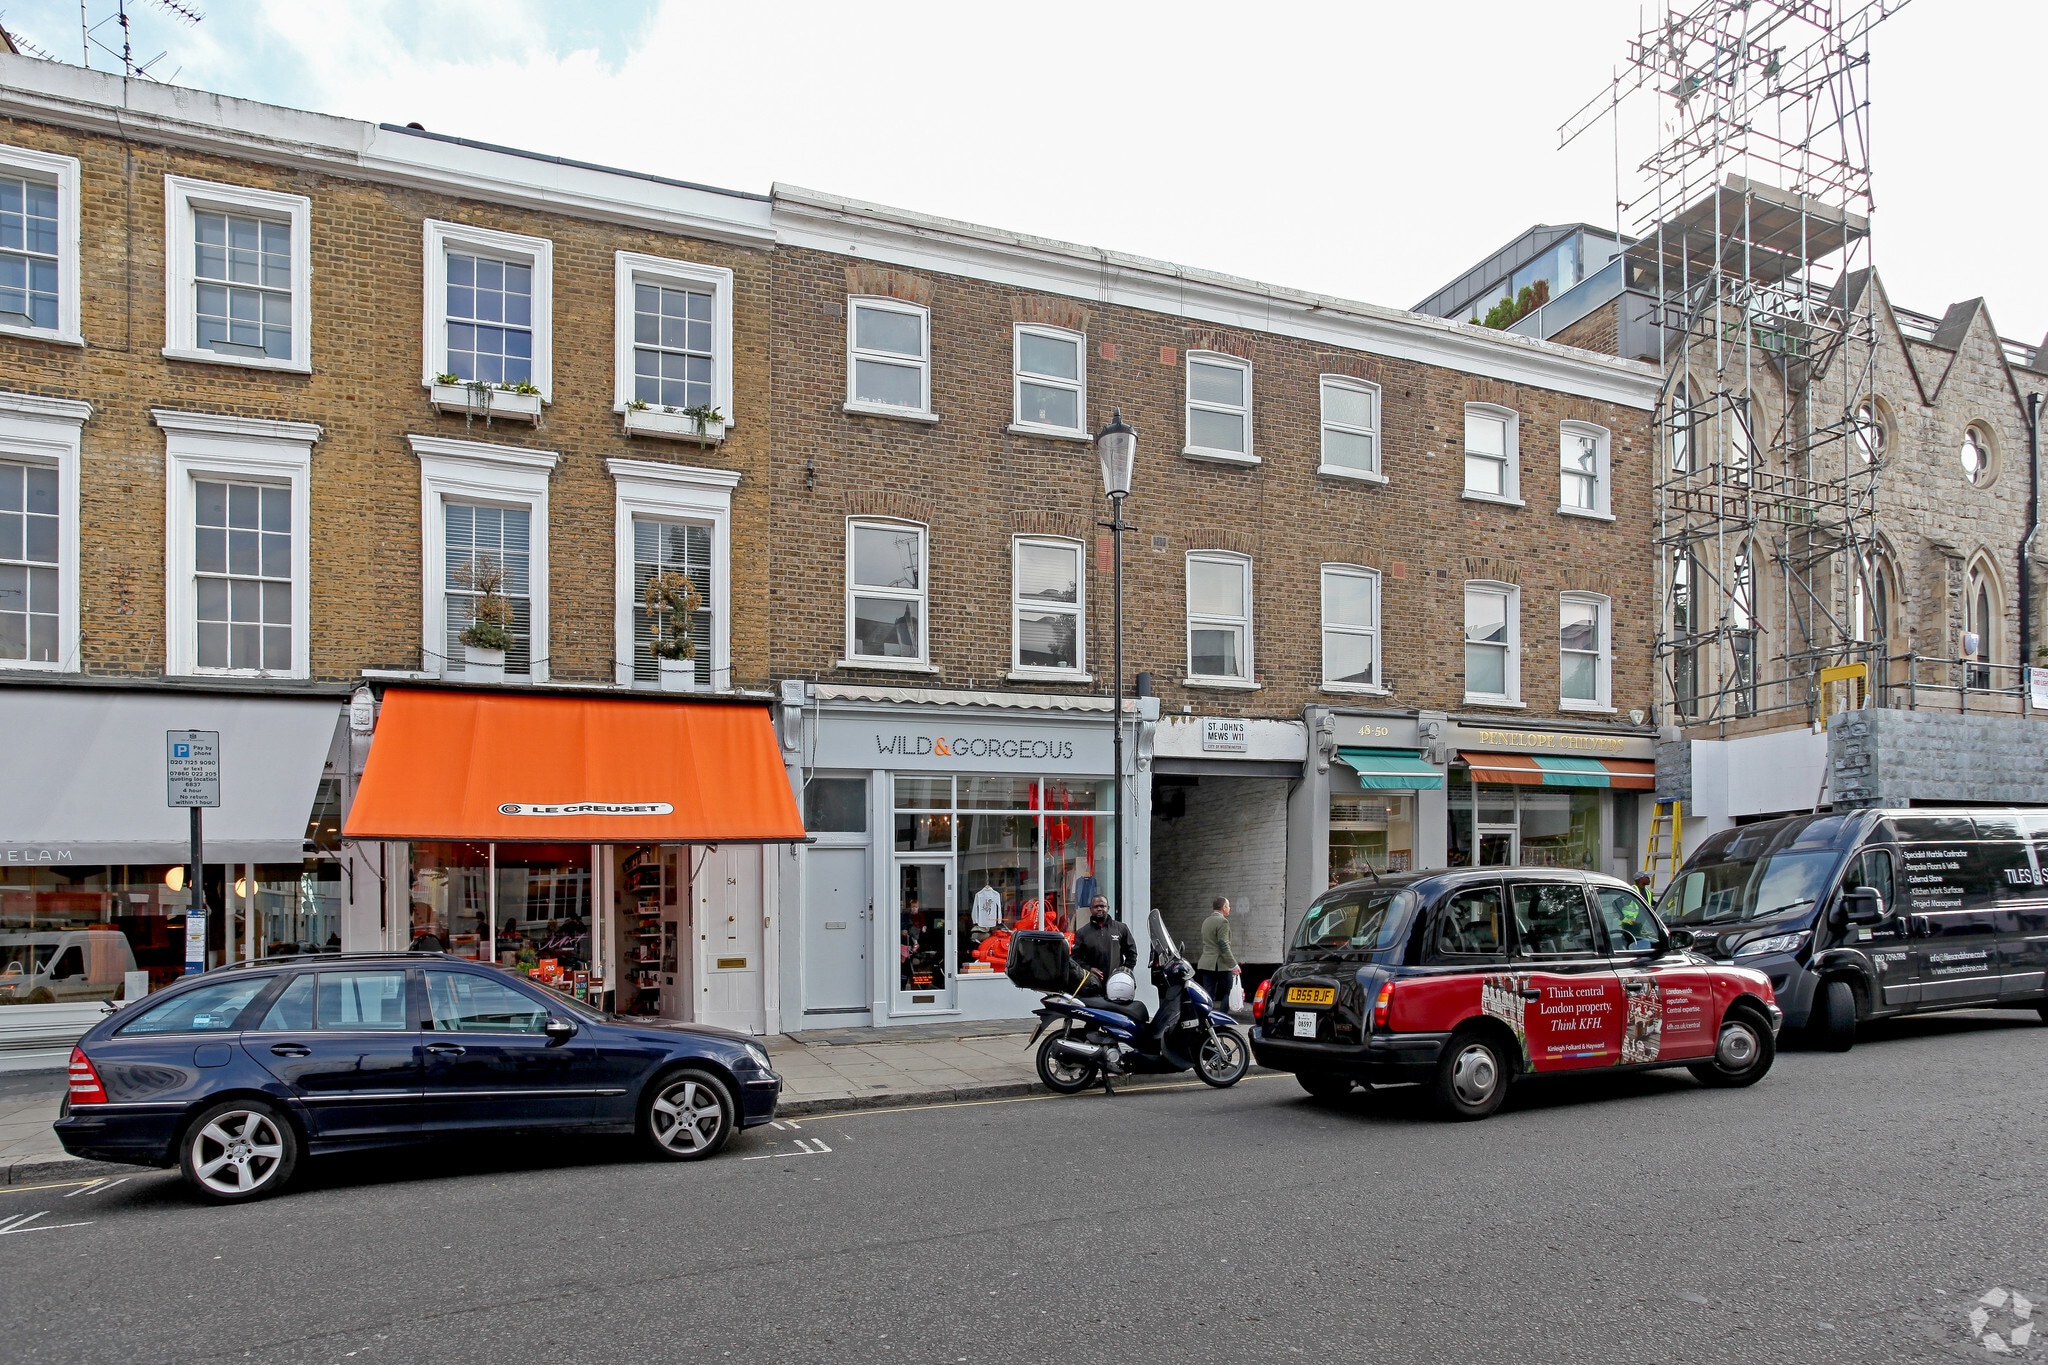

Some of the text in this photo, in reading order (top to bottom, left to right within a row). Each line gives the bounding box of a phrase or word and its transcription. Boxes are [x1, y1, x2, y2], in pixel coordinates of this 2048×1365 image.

[1208, 722, 1244, 731] ST. JOHN'S
[1208, 732, 1244, 741] MEWS W11
[1479, 730, 1625, 753] PENELOPE CHILVERS
[0, 850, 73, 861] ELAM
[1904, 850, 1926, 860] Specialist
[1906, 863, 1927, 872] Bespoke
[1927, 862, 1942, 870] Floors
[1946, 861, 1960, 869] Walls
[1909, 875, 1928, 883] External
[2004, 868, 2032, 884] TILES
[1912, 887, 1930, 895] Kitchen
[1943, 886, 1965, 894] Surfaces
[1913, 899, 1962, 909] Project Management
[1291, 989, 1331, 1002] LB55 BJF
[1547, 985, 1604, 999] Think central
[1540, 1002, 1613, 1016] London property.
[1551, 1017, 1603, 1032] Think KFH.
[1547, 1044, 1565, 1052] Kinleigh
[1566, 1043, 1582, 1051] Folkard
[1586, 1042, 1605, 1050] Hayward
